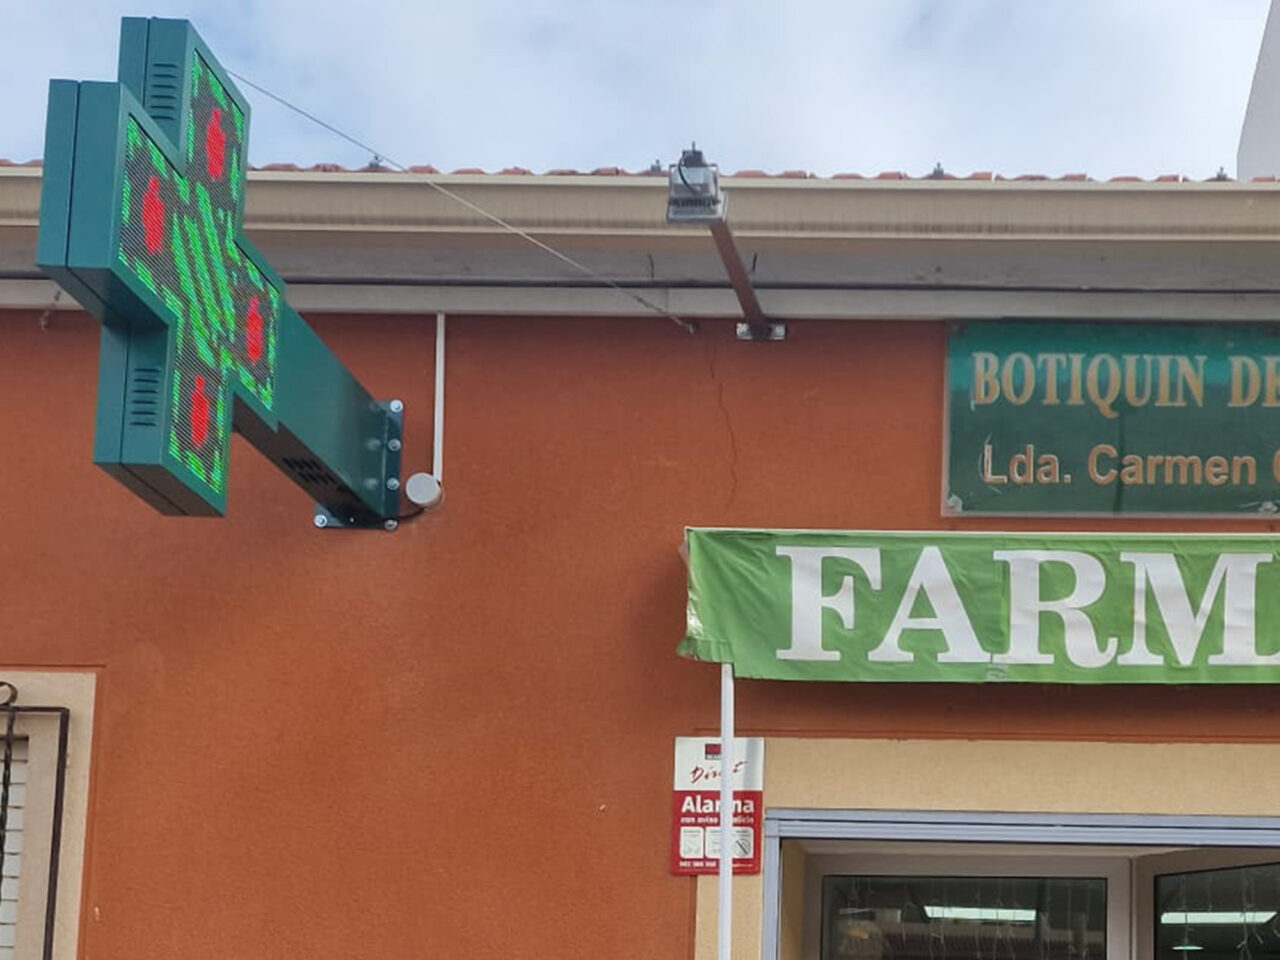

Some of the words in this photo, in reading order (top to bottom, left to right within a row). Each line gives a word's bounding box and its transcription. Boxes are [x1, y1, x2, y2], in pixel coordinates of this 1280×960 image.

[972, 352, 1207, 419] BOTIQUIN
[983, 444, 1072, 484] Lda.
[1088, 444, 1257, 485] Carmen
